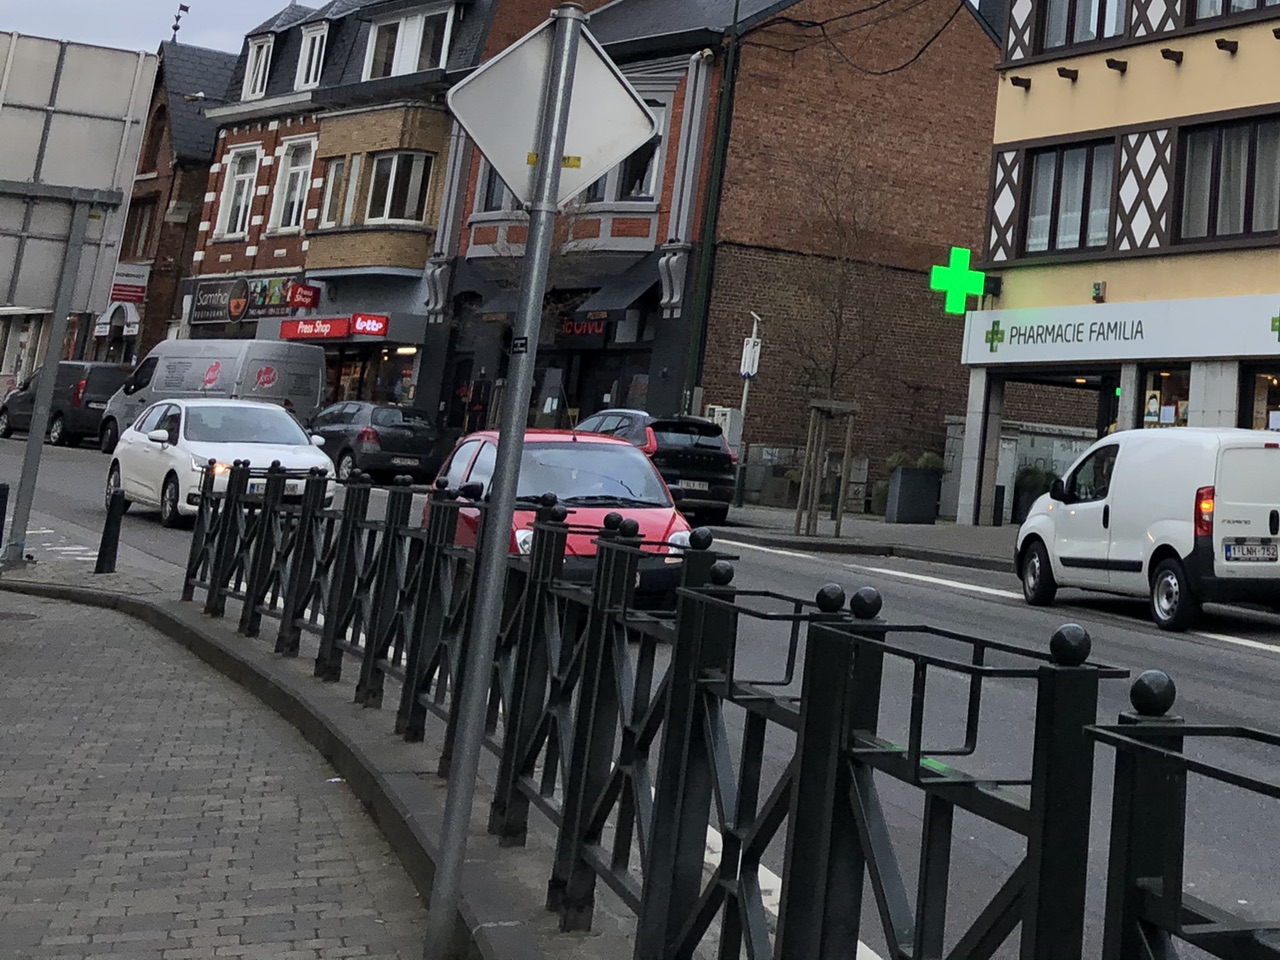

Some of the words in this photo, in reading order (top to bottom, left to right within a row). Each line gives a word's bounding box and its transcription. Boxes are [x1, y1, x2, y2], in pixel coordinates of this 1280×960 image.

[298, 321, 313, 334] Press
[314, 320, 331, 337] Shop
[1009, 322, 1085, 345] PHARMACIE
[1089, 319, 1144, 342] FAMILIA
